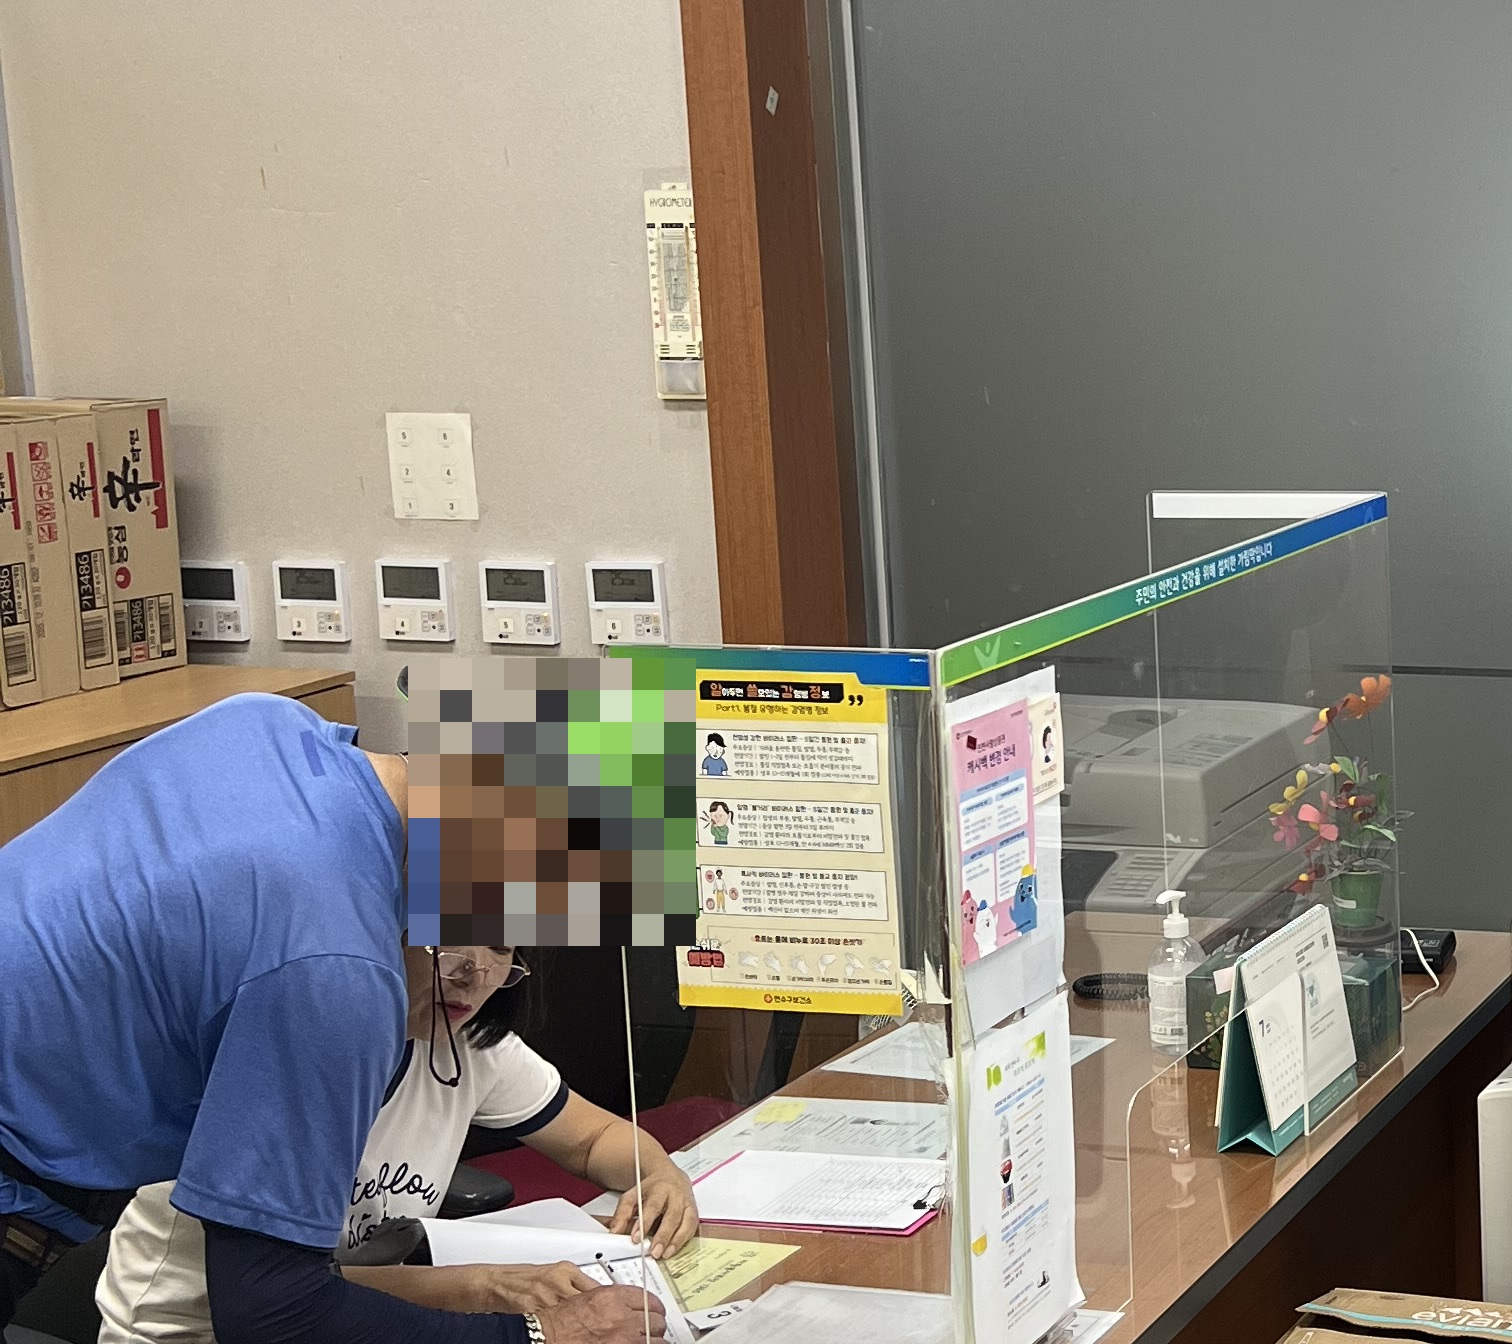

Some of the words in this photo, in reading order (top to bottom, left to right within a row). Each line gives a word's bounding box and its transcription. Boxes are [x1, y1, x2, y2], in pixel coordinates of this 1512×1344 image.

[1135, 583, 1157, 606] 주민의
[1159, 575, 1180, 598] 안전과
[1181, 567, 1201, 590] 건강을
[1202, 562, 1216, 581] 위해
[1217, 555, 1237, 576] 설치한
[1238, 541, 1273, 568] 가림막입니다
